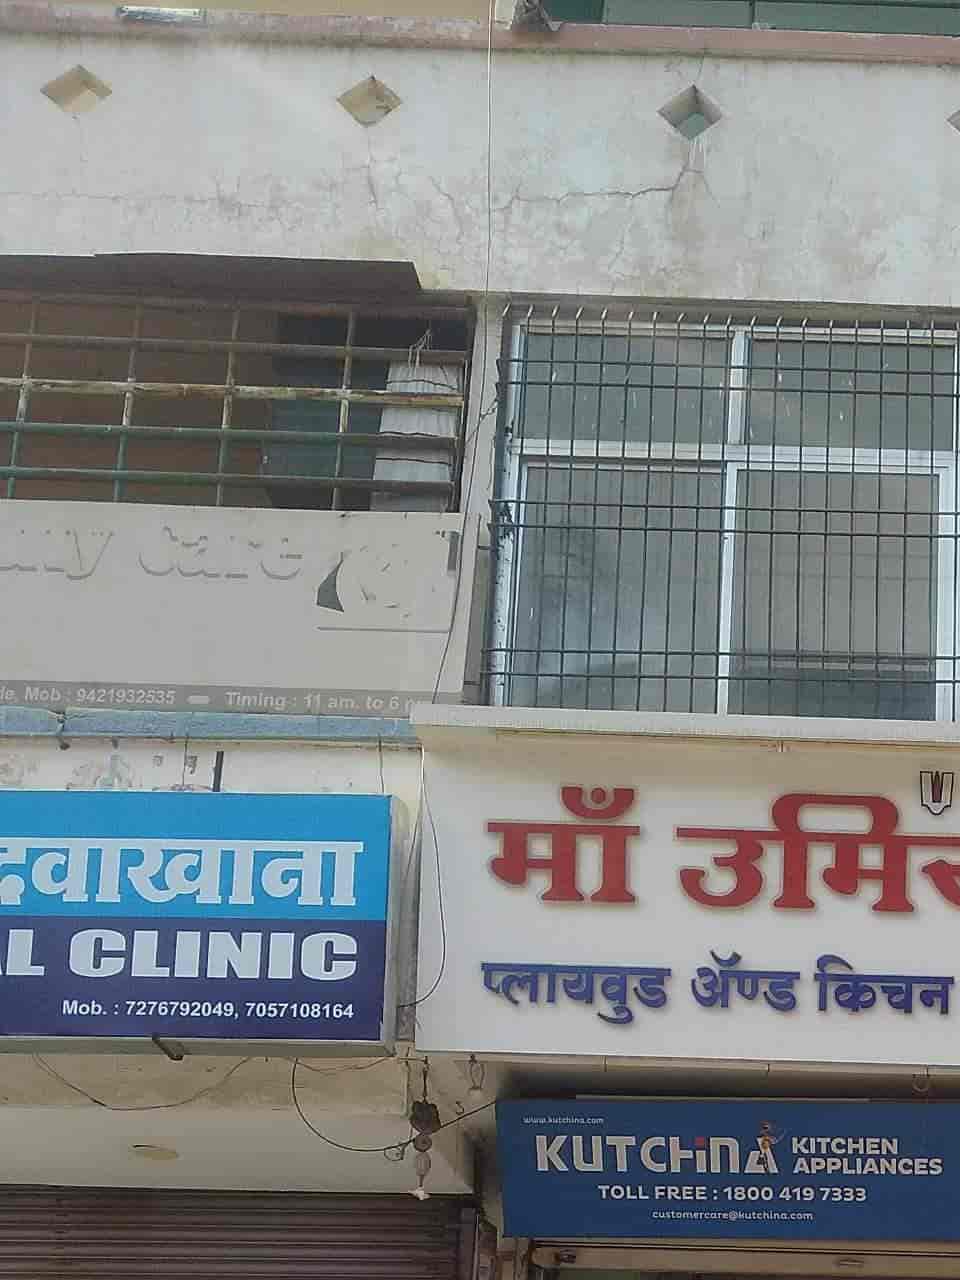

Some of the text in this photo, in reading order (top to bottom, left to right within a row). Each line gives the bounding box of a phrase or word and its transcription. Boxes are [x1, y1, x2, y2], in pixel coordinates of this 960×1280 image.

[224, 691, 287, 710] Timing
[366, 696, 385, 710] to
[69, 928, 358, 981] CLINIC
[481, 961, 671, 1024] प्लायवुड
[815, 954, 954, 1016] किचन
[62, 1000, 108, 1016] Mob.
[126, 1001, 239, 1020] 7276792049,
[245, 1001, 354, 1019] 7057108164
[791, 1137, 899, 1155] KITCHEN
[791, 1157, 943, 1177] APPLIANCES
[598, 1184, 649, 1201] TOLL
[654, 1186, 707, 1201] FREE
[723, 1187, 773, 1202] 1800
[779, 1187, 814, 1202] 419
[820, 1187, 866, 1202] 7333
[651, 1209, 814, 1222] customercare@kutchina.com
